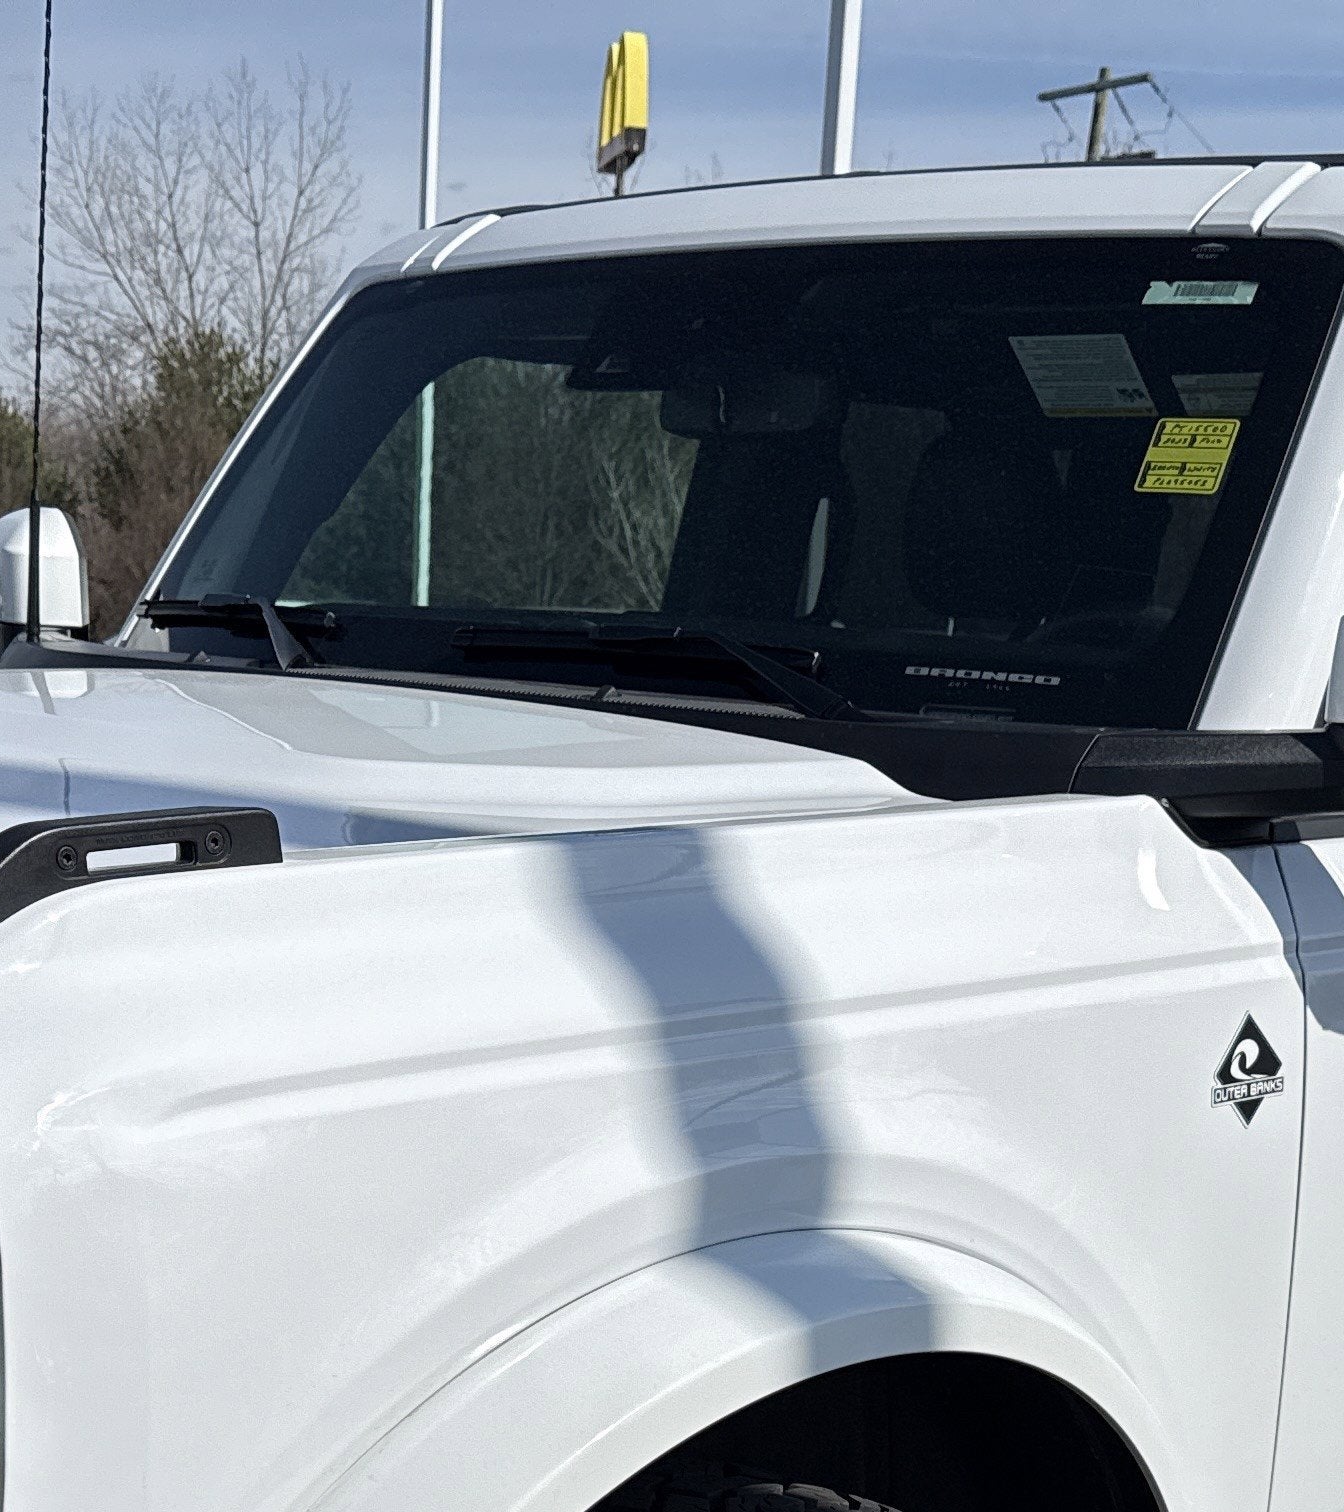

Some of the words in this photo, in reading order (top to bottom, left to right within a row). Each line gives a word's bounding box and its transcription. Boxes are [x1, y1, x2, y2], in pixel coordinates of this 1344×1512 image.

[905, 666, 1061, 686] BRONCO
[1215, 1085, 1248, 1103] OUTER
[1249, 1078, 1284, 1096] BANKS
